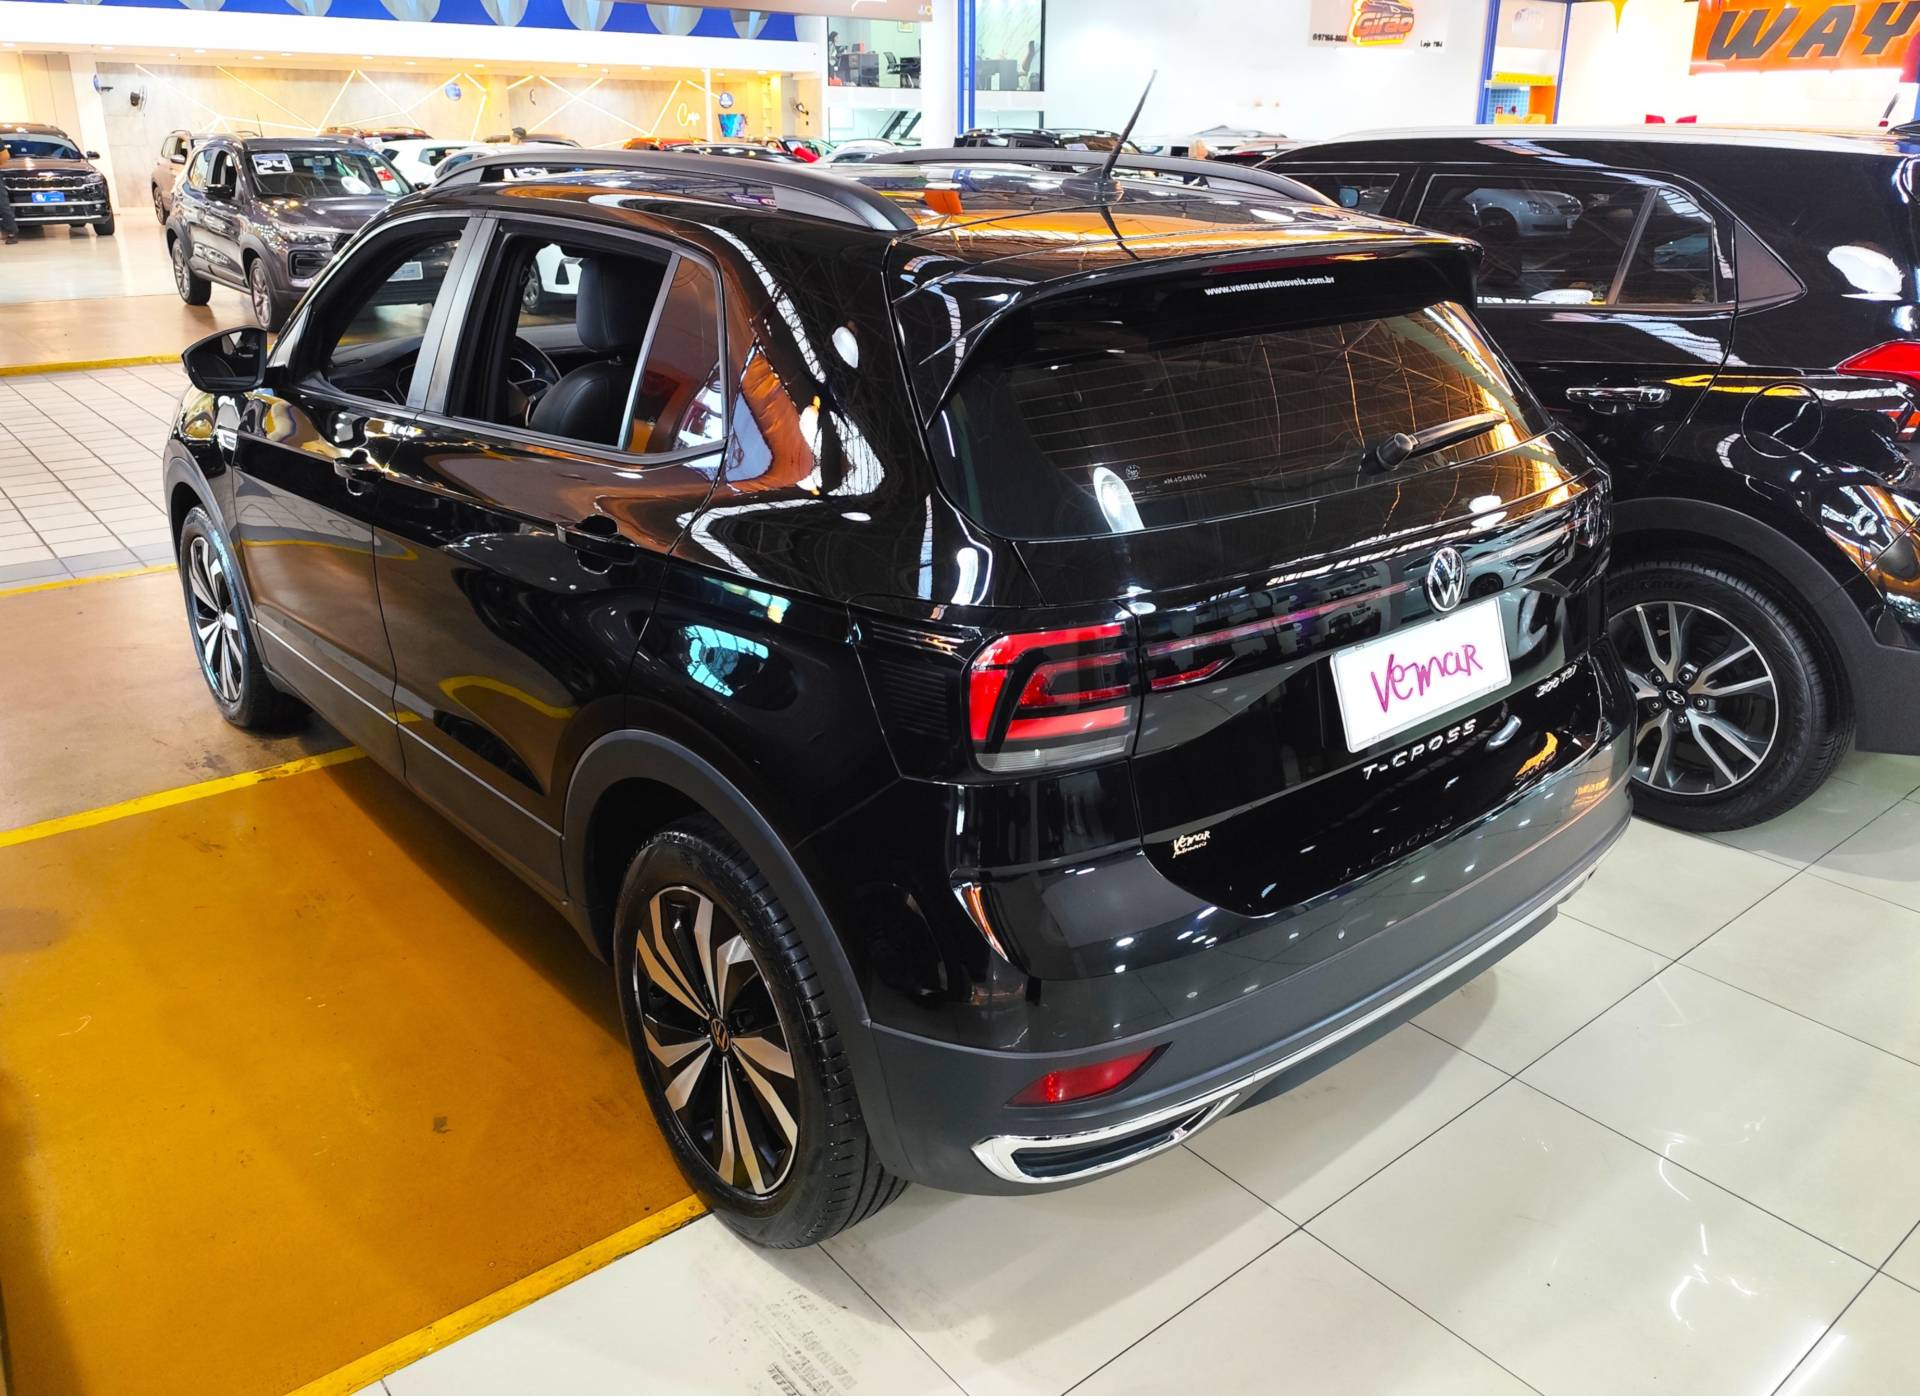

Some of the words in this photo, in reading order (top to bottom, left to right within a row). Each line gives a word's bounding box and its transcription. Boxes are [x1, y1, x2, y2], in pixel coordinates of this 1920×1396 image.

[1706, 1, 1920, 60] WAY
[256, 160, 291, 173] 24
[1204, 275, 1335, 296] www.vemarautomoveis.com.br
[1362, 718, 1477, 781] T-CROSS
